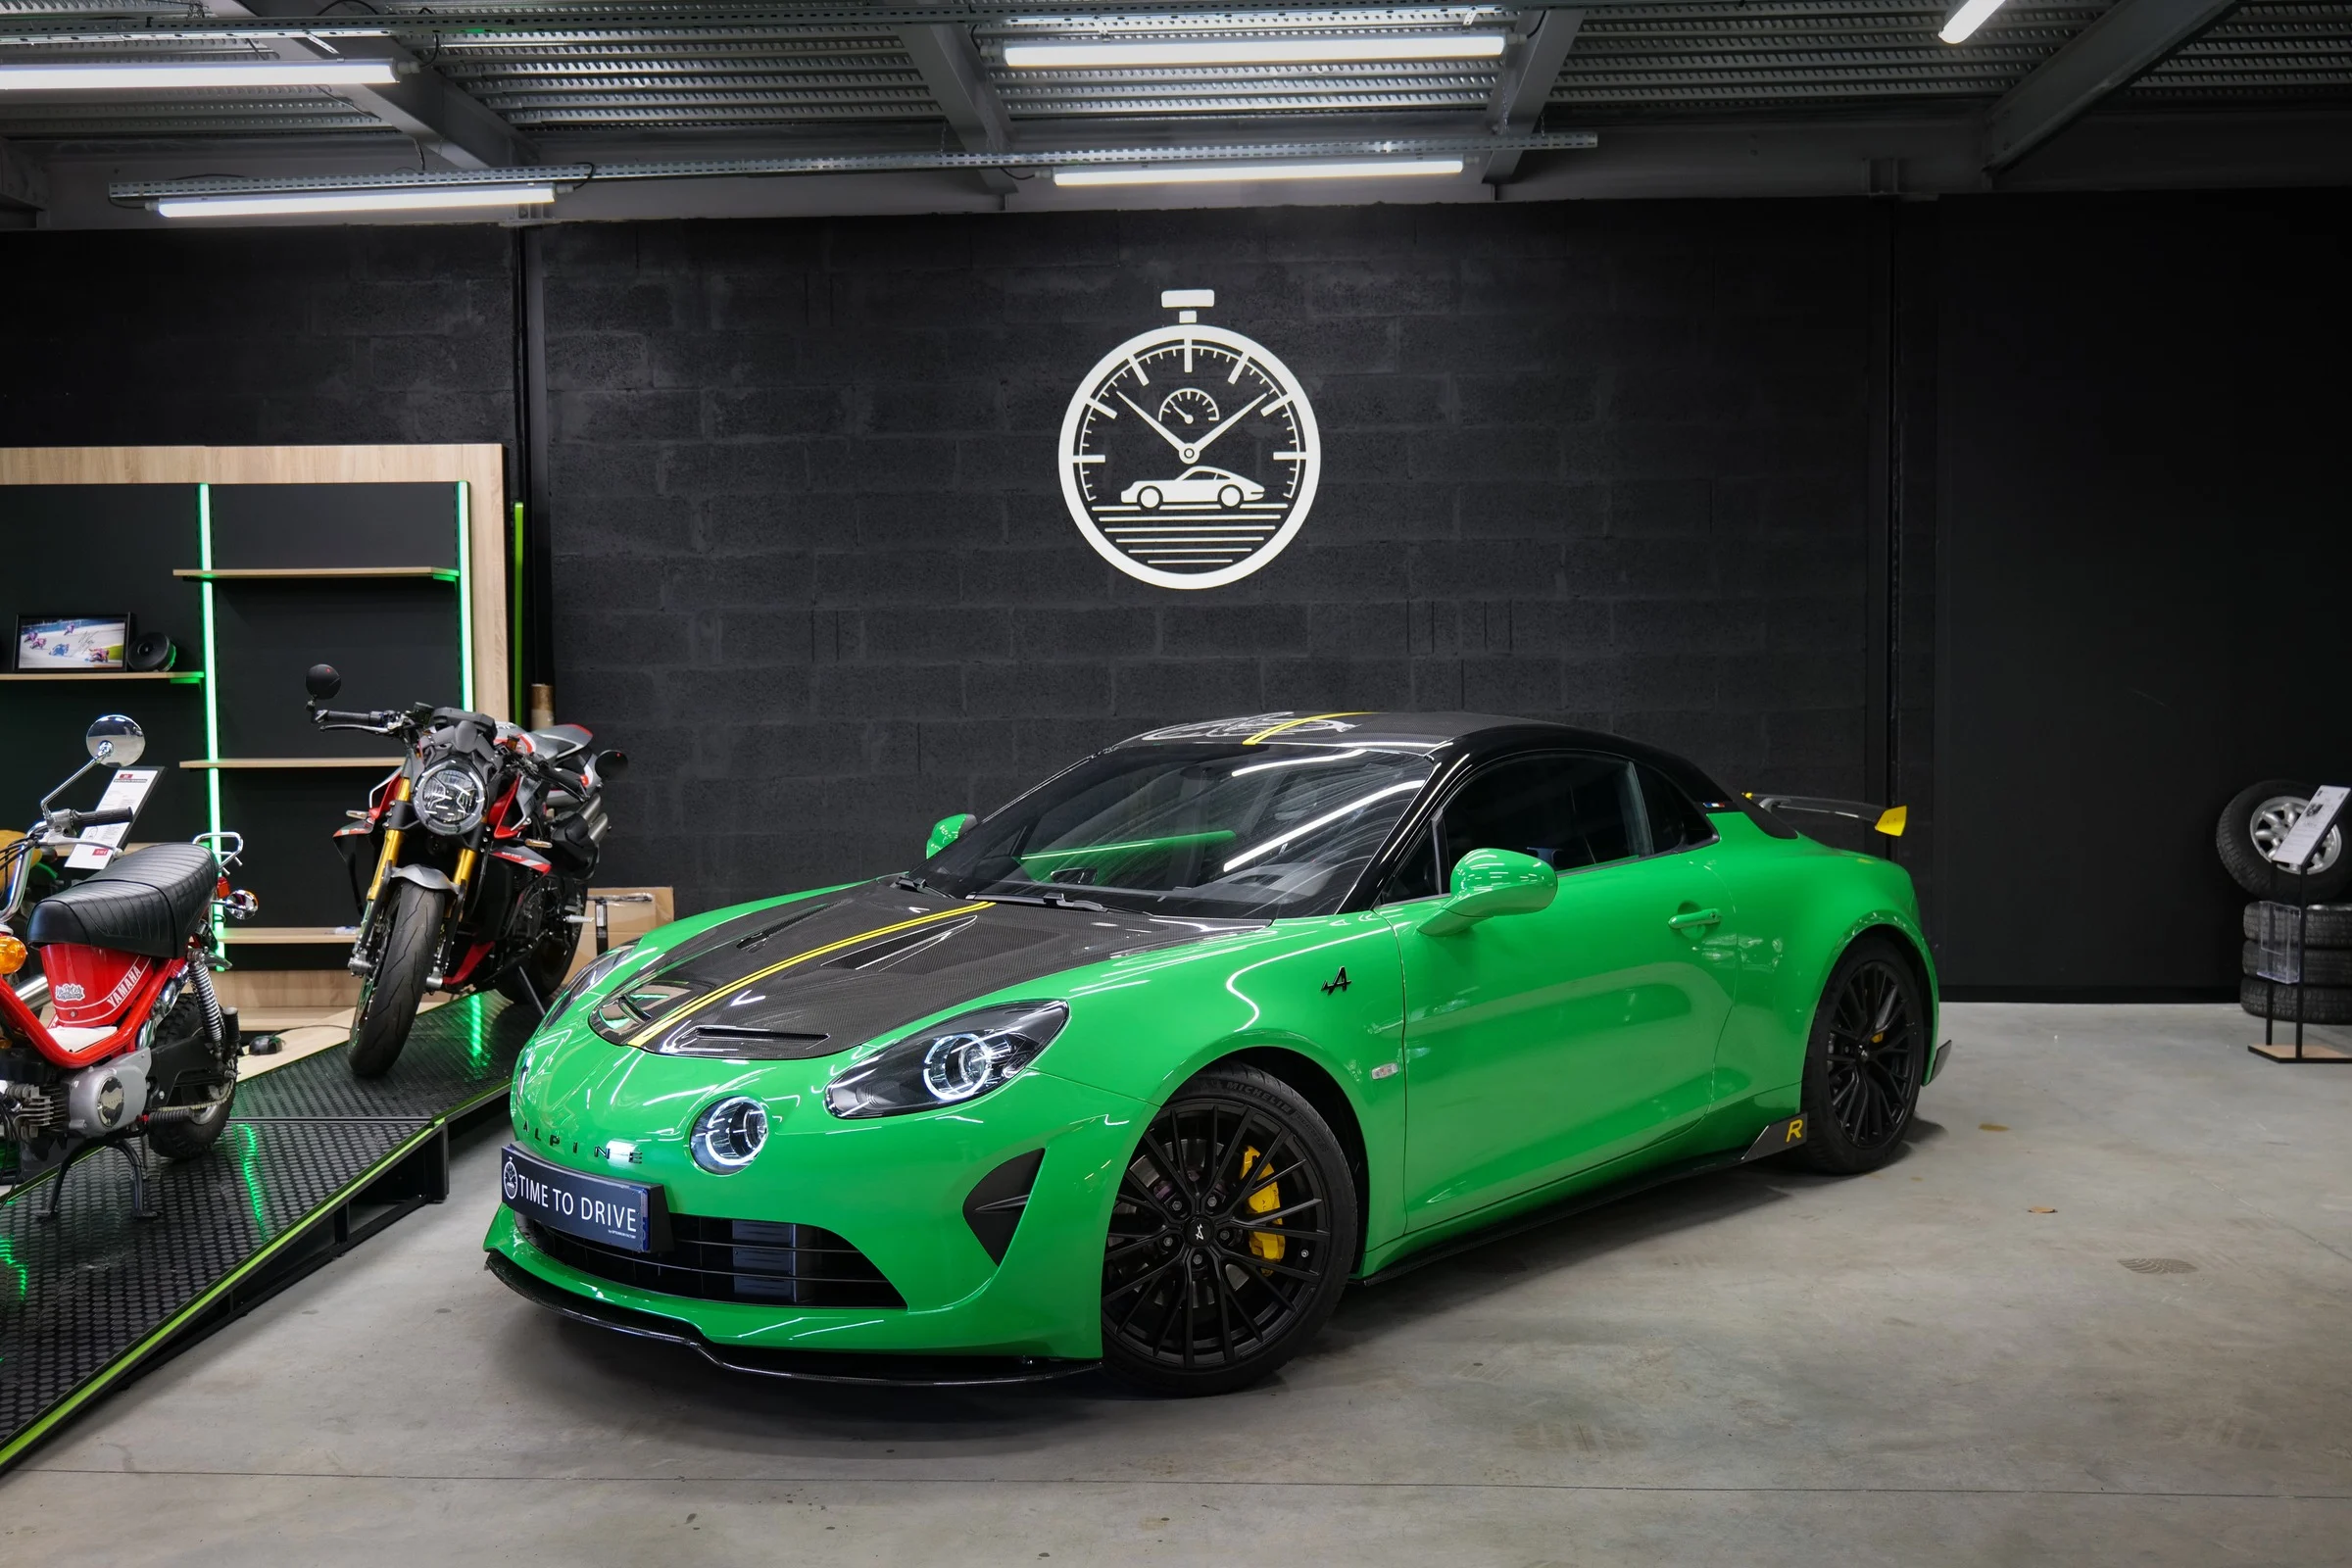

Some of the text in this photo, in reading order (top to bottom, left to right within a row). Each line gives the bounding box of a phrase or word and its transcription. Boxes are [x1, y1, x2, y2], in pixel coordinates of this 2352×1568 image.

[107, 965, 141, 1007] YAMAHA
[1226, 1081, 1292, 1113] MICHELIN
[522, 1120, 643, 1165] ALPINE
[1786, 1119, 1803, 1143] R
[519, 1175, 636, 1232] TIME TO DRIVE
